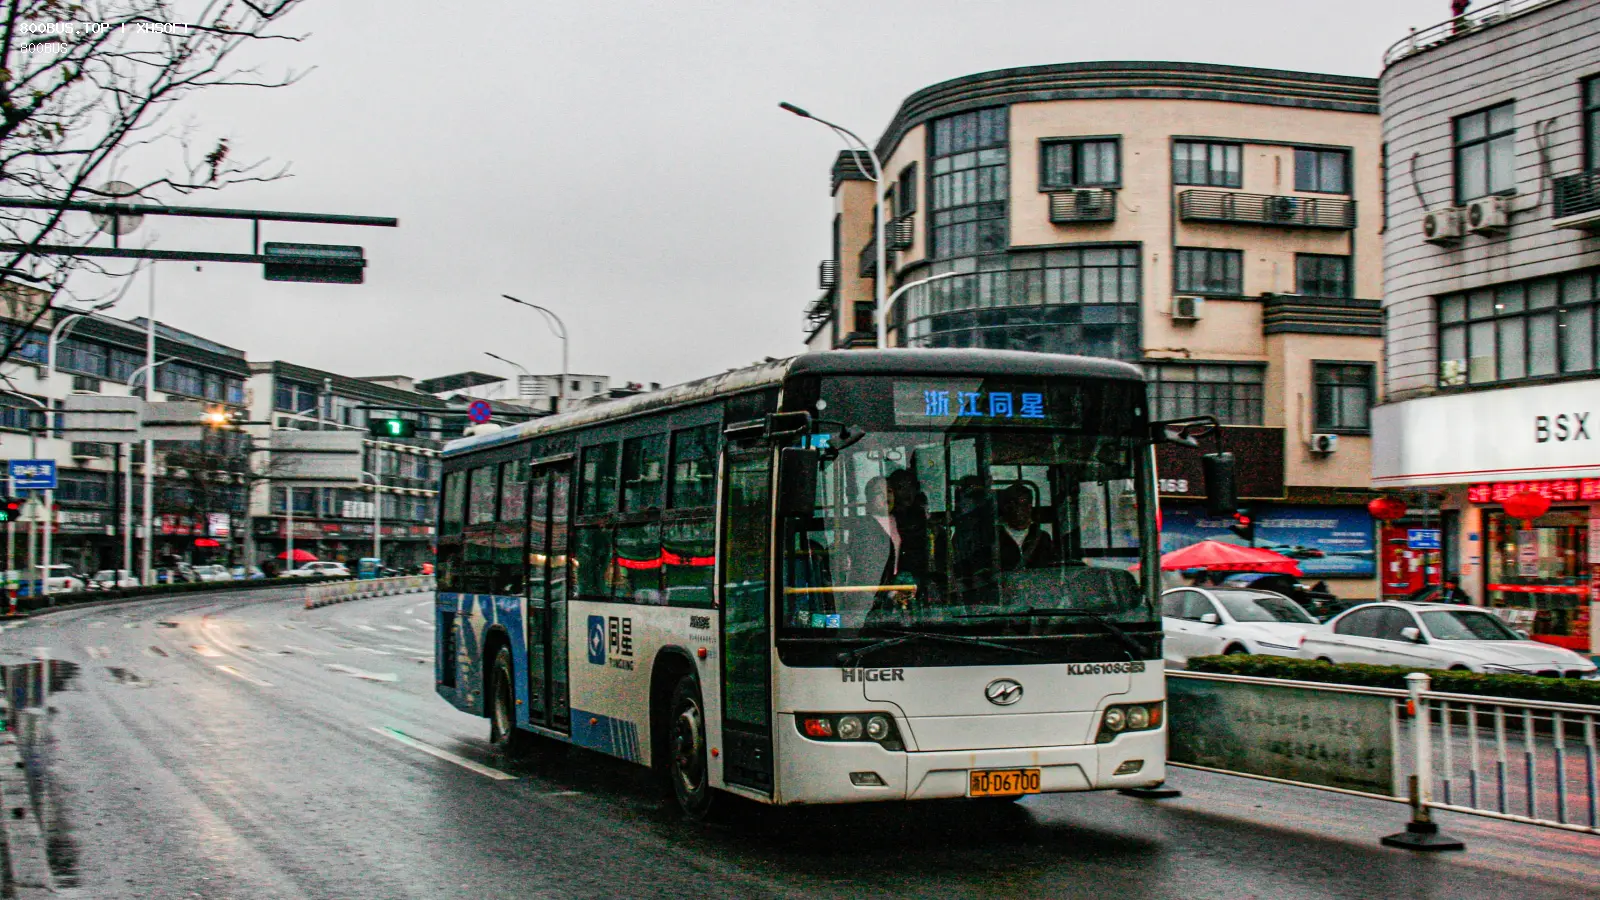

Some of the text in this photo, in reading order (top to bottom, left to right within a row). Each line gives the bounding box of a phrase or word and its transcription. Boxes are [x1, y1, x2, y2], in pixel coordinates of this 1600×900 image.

[923, 389, 1045, 419] 浙江同星
[1534, 411, 1591, 444] BSX
[608, 616, 633, 656] 同星
[842, 668, 904, 683] HIGER
